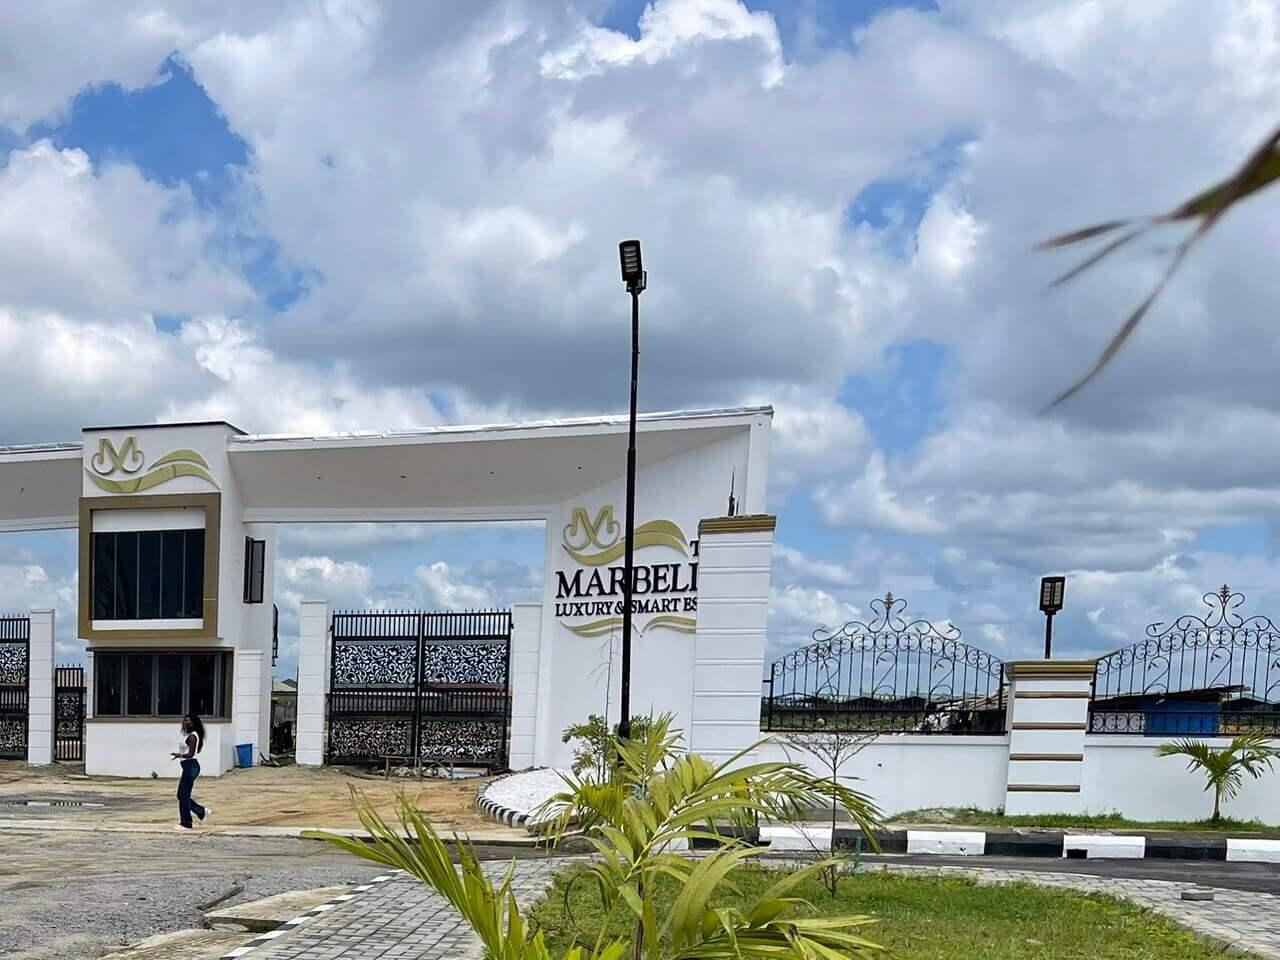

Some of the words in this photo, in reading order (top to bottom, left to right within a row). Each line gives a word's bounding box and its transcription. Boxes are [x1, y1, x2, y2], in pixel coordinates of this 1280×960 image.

[555, 601, 613, 617] LUXURY
[614, 600, 625, 615] &
[631, 598, 682, 614] SMART
